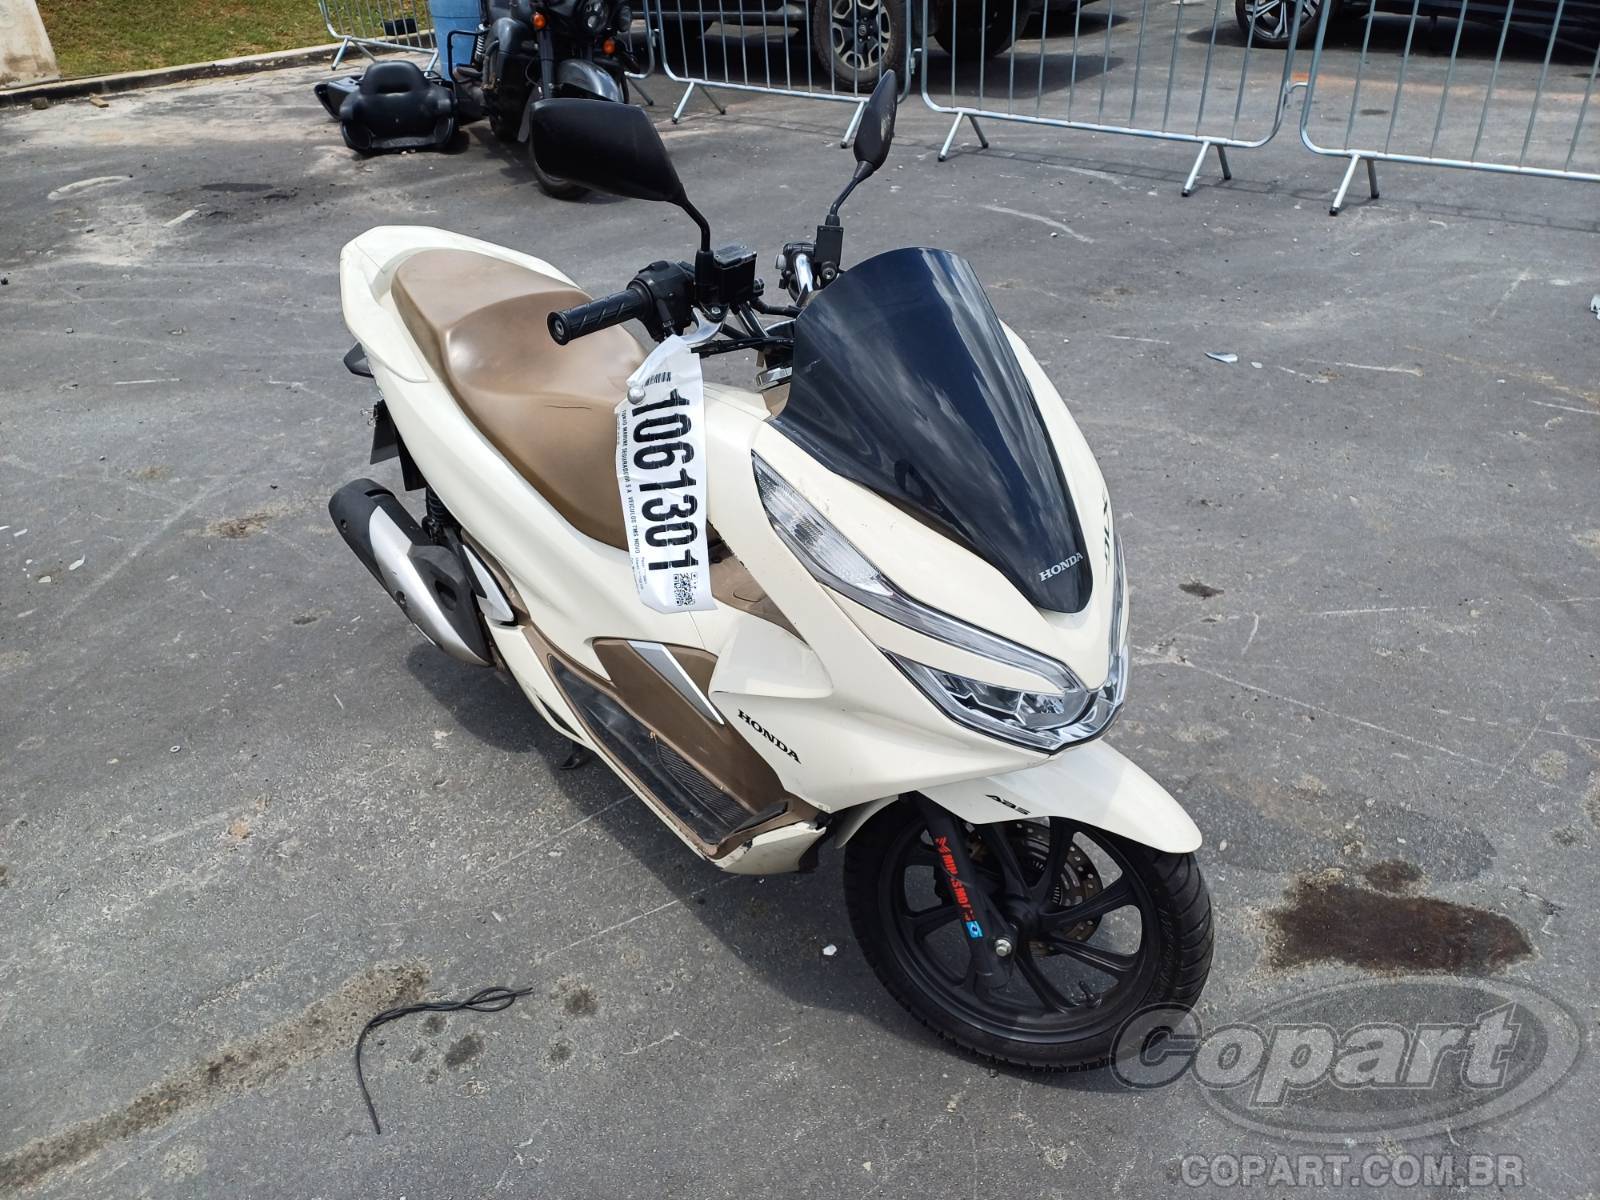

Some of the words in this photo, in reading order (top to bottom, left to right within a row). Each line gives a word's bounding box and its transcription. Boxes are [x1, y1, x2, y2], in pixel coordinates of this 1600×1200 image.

[632, 388, 698, 570] 1061301
[1039, 552, 1083, 581] HONDA
[738, 708, 802, 764] HONDA
